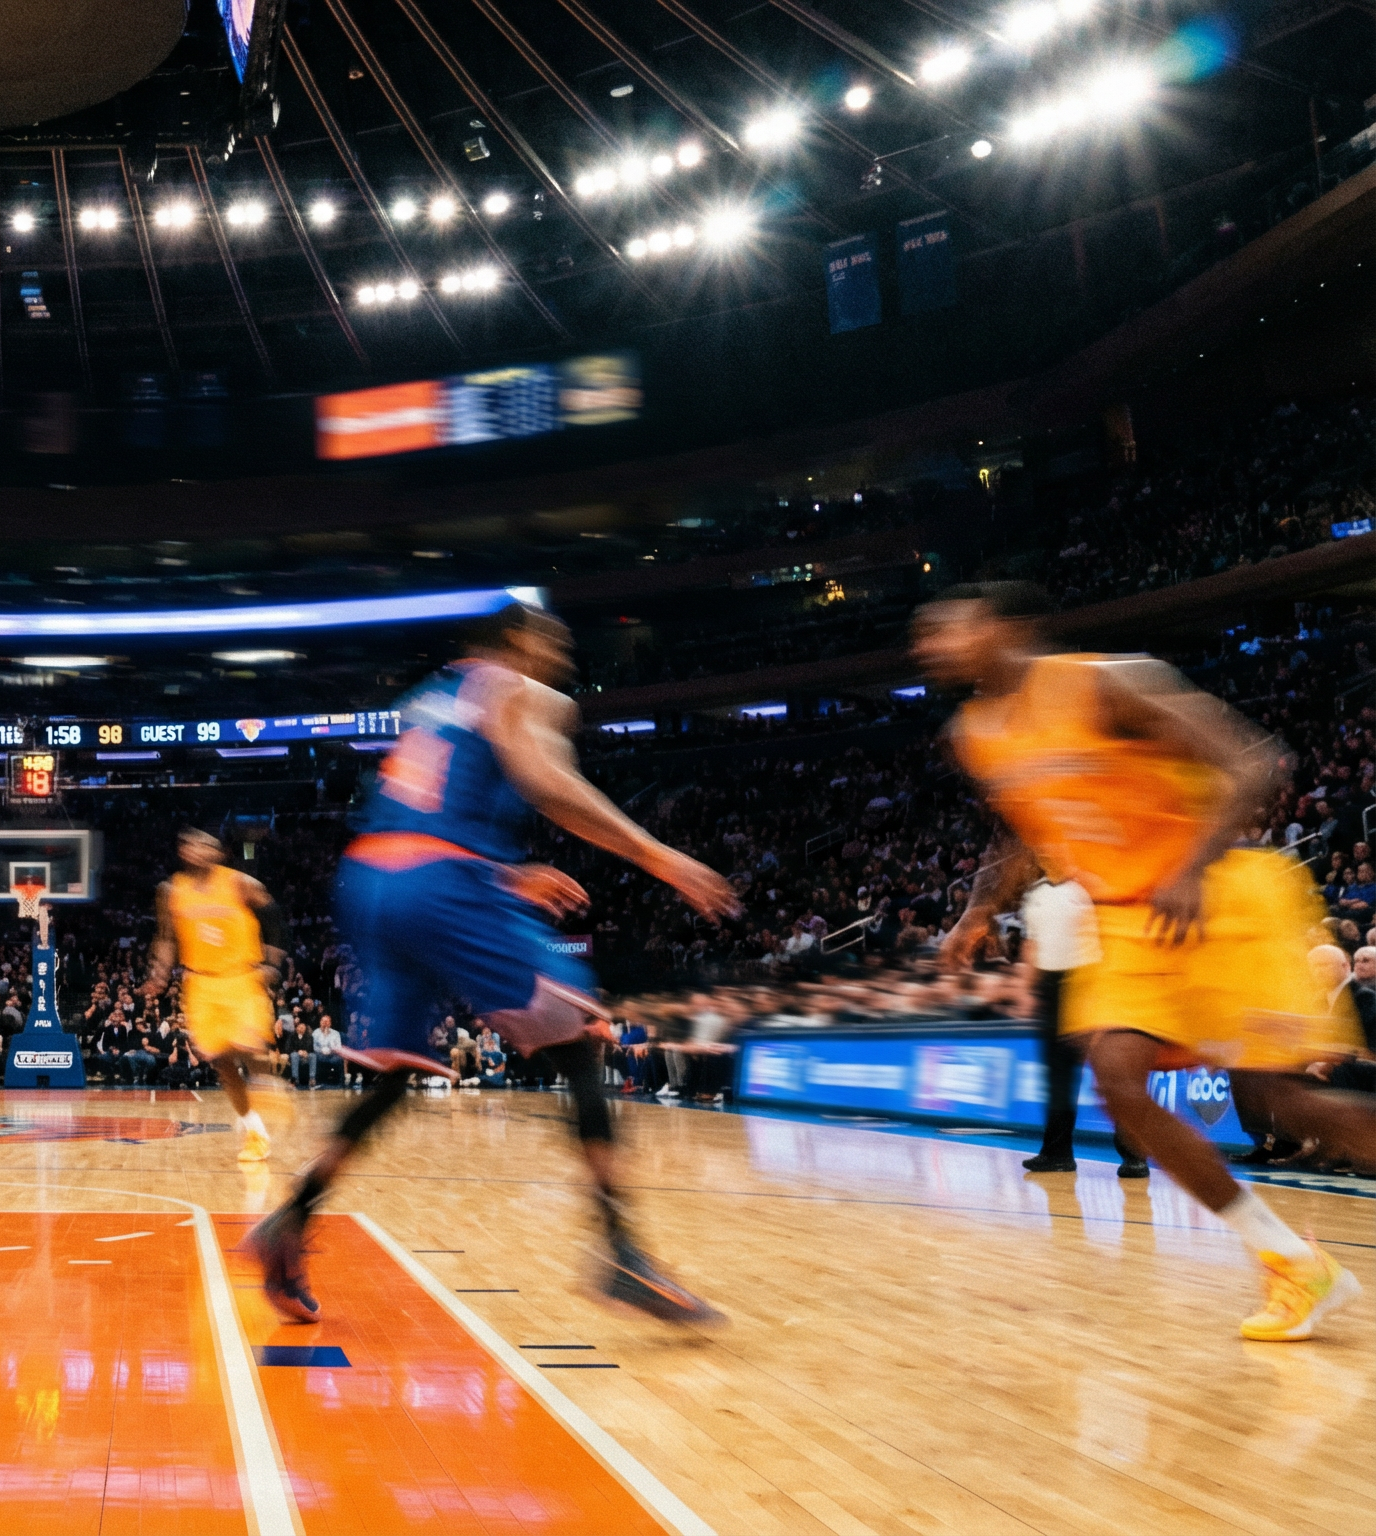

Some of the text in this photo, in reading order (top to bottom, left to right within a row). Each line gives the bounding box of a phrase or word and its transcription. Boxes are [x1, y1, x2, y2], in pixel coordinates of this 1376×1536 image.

[45, 725, 81, 745] 1:58
[98, 725, 123, 745] 98
[140, 725, 185, 742] GUEST
[197, 722, 220, 742] 99
